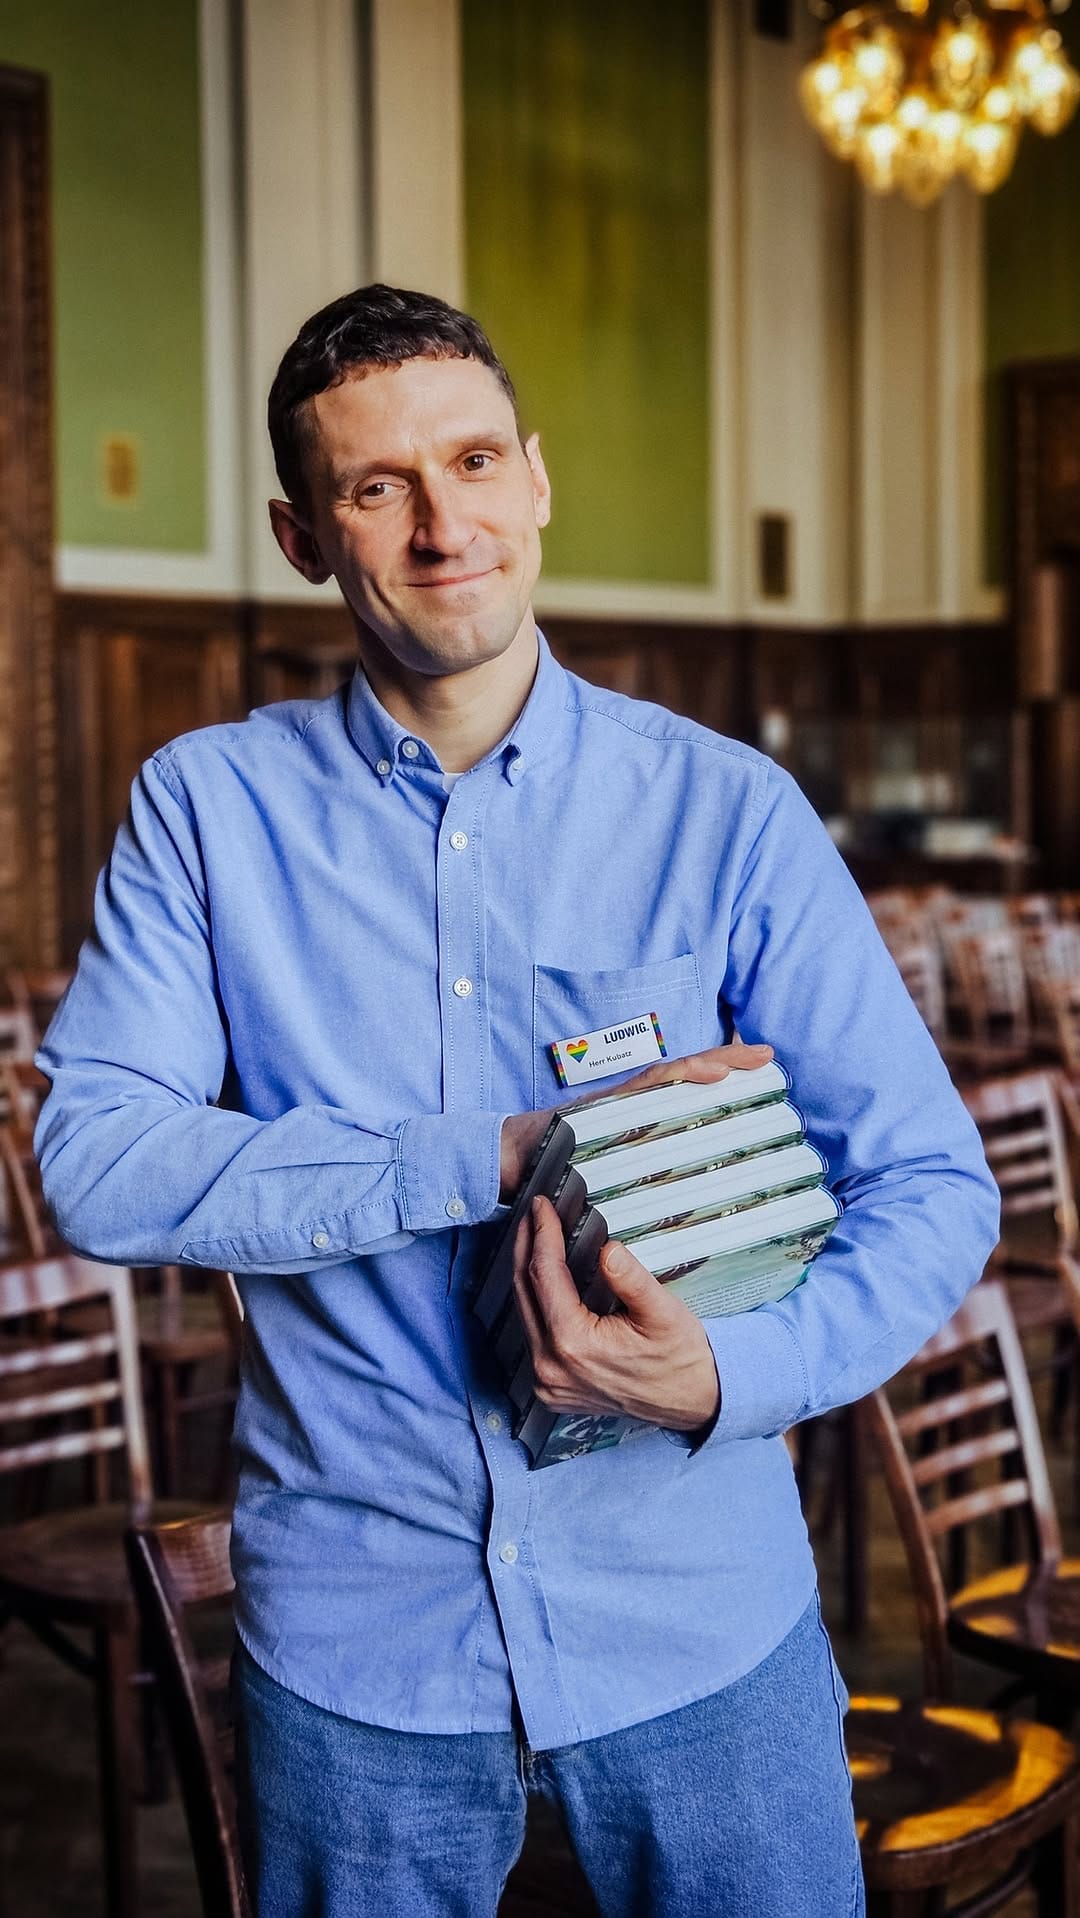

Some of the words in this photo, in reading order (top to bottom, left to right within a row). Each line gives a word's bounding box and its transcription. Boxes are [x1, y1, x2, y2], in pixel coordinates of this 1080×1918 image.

[603, 1022, 650, 1044] LUDWIG.
[588, 1058, 605, 1068] Herr
[606, 1050, 632, 1063] Kubatz
